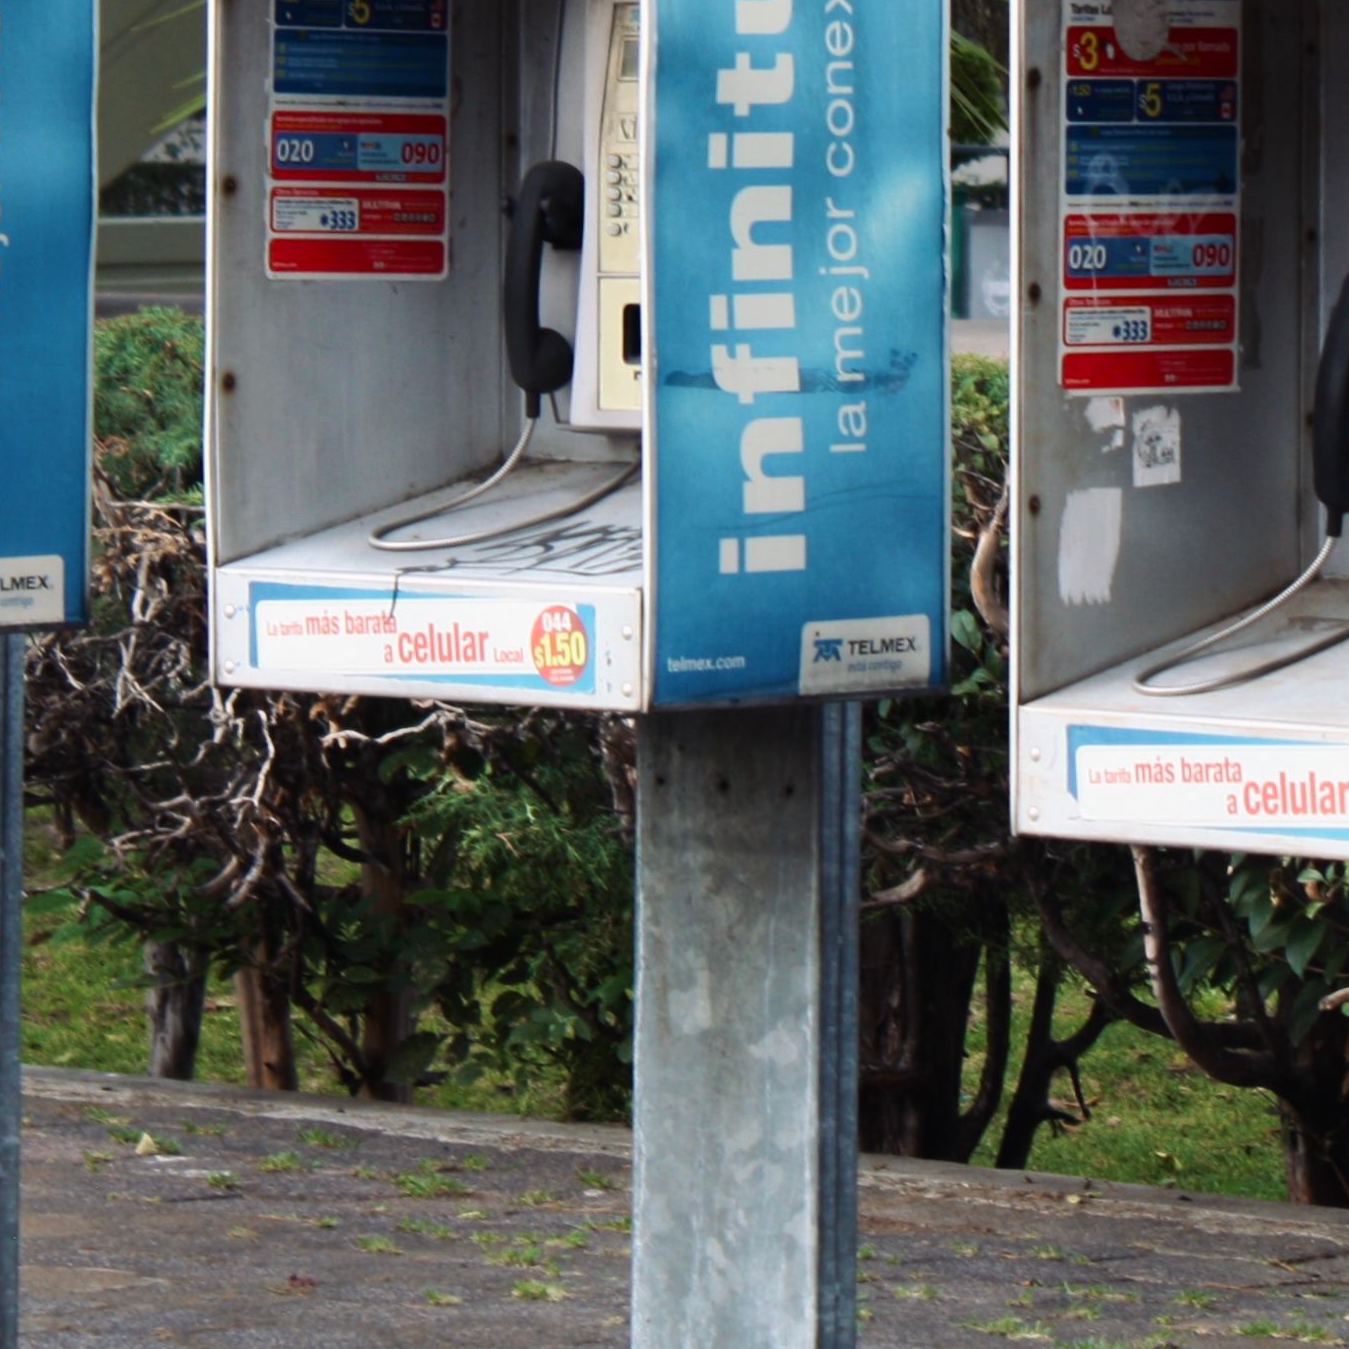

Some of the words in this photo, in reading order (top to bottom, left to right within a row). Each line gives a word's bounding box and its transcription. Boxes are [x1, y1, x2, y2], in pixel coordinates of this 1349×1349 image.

[277, 139, 314, 163] 020
[401, 142, 440, 165] 090
[1068, 244, 1107, 270] 020
[1192, 243, 1230, 268] 090
[819, 199, 870, 384] mejor
[829, 400, 867, 453] la
[306, 610, 340, 635] más
[345, 610, 398, 635] barata
[541, 611, 572, 631] 044
[384, 643, 393, 663] a
[398, 622, 489, 664] celular
[493, 646, 524, 663] Local
[534, 631, 586, 667] $1.50
[848, 637, 917, 656] TELMEX
[667, 655, 746, 673] telmex.com
[1135, 756, 1174, 784] más
[1181, 756, 1242, 784] barata
[1227, 795, 1237, 814] a
[1244, 771, 1349, 815] celular
